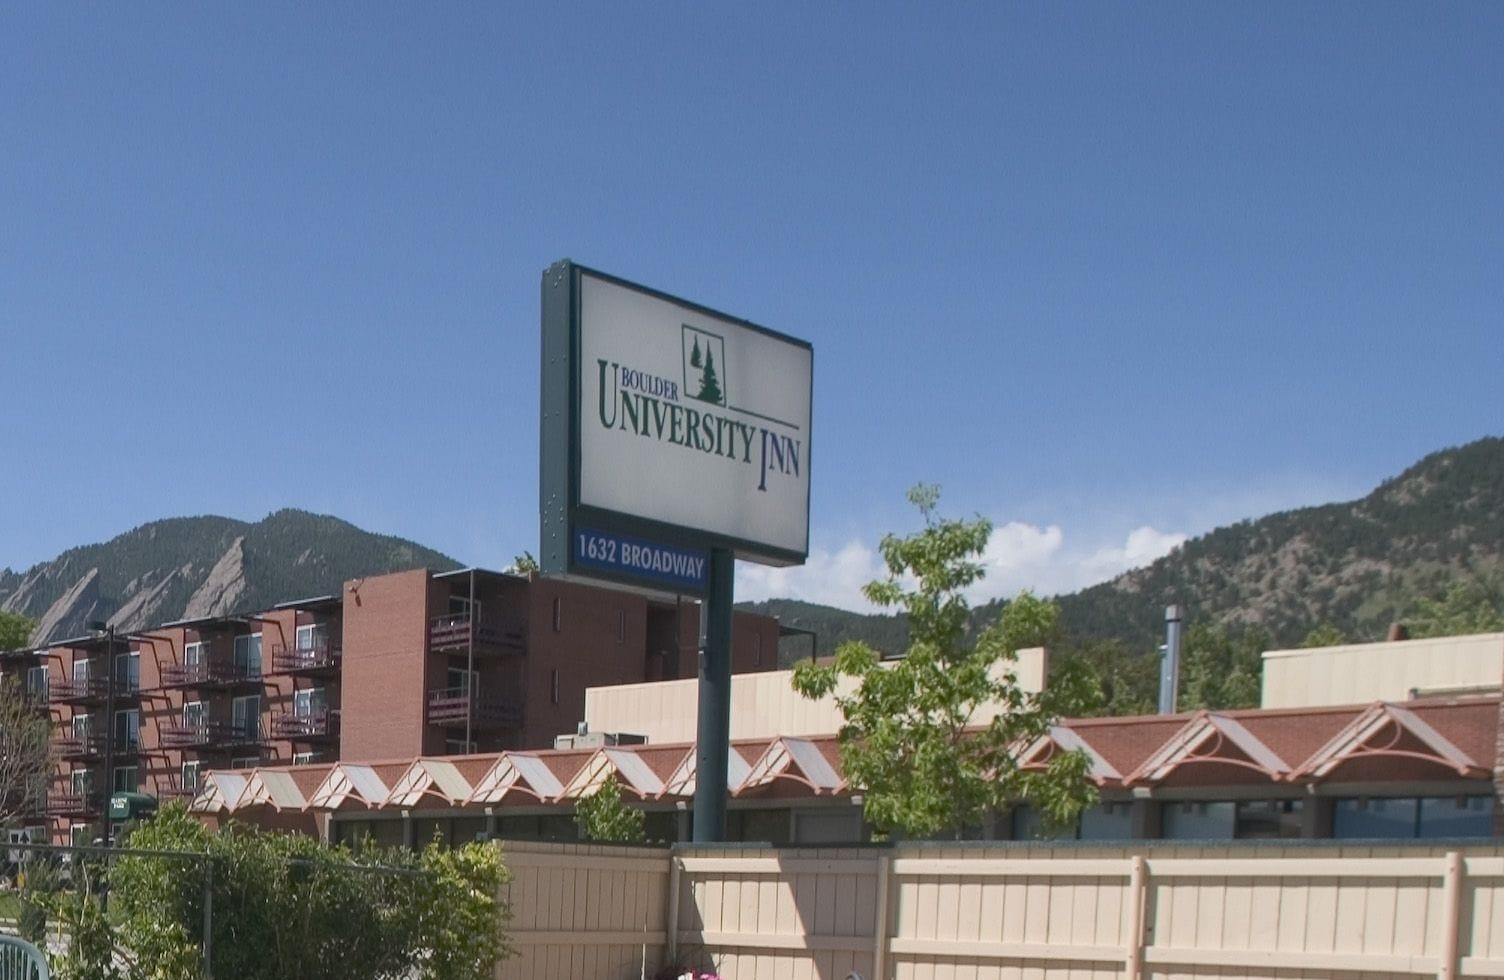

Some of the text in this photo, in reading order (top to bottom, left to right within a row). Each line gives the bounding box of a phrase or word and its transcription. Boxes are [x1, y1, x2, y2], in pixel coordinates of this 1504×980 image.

[621, 367, 679, 402] BOULDER
[597, 358, 801, 492] UNIVERSITY INN
[578, 533, 705, 580] 1632 BROADWAY
